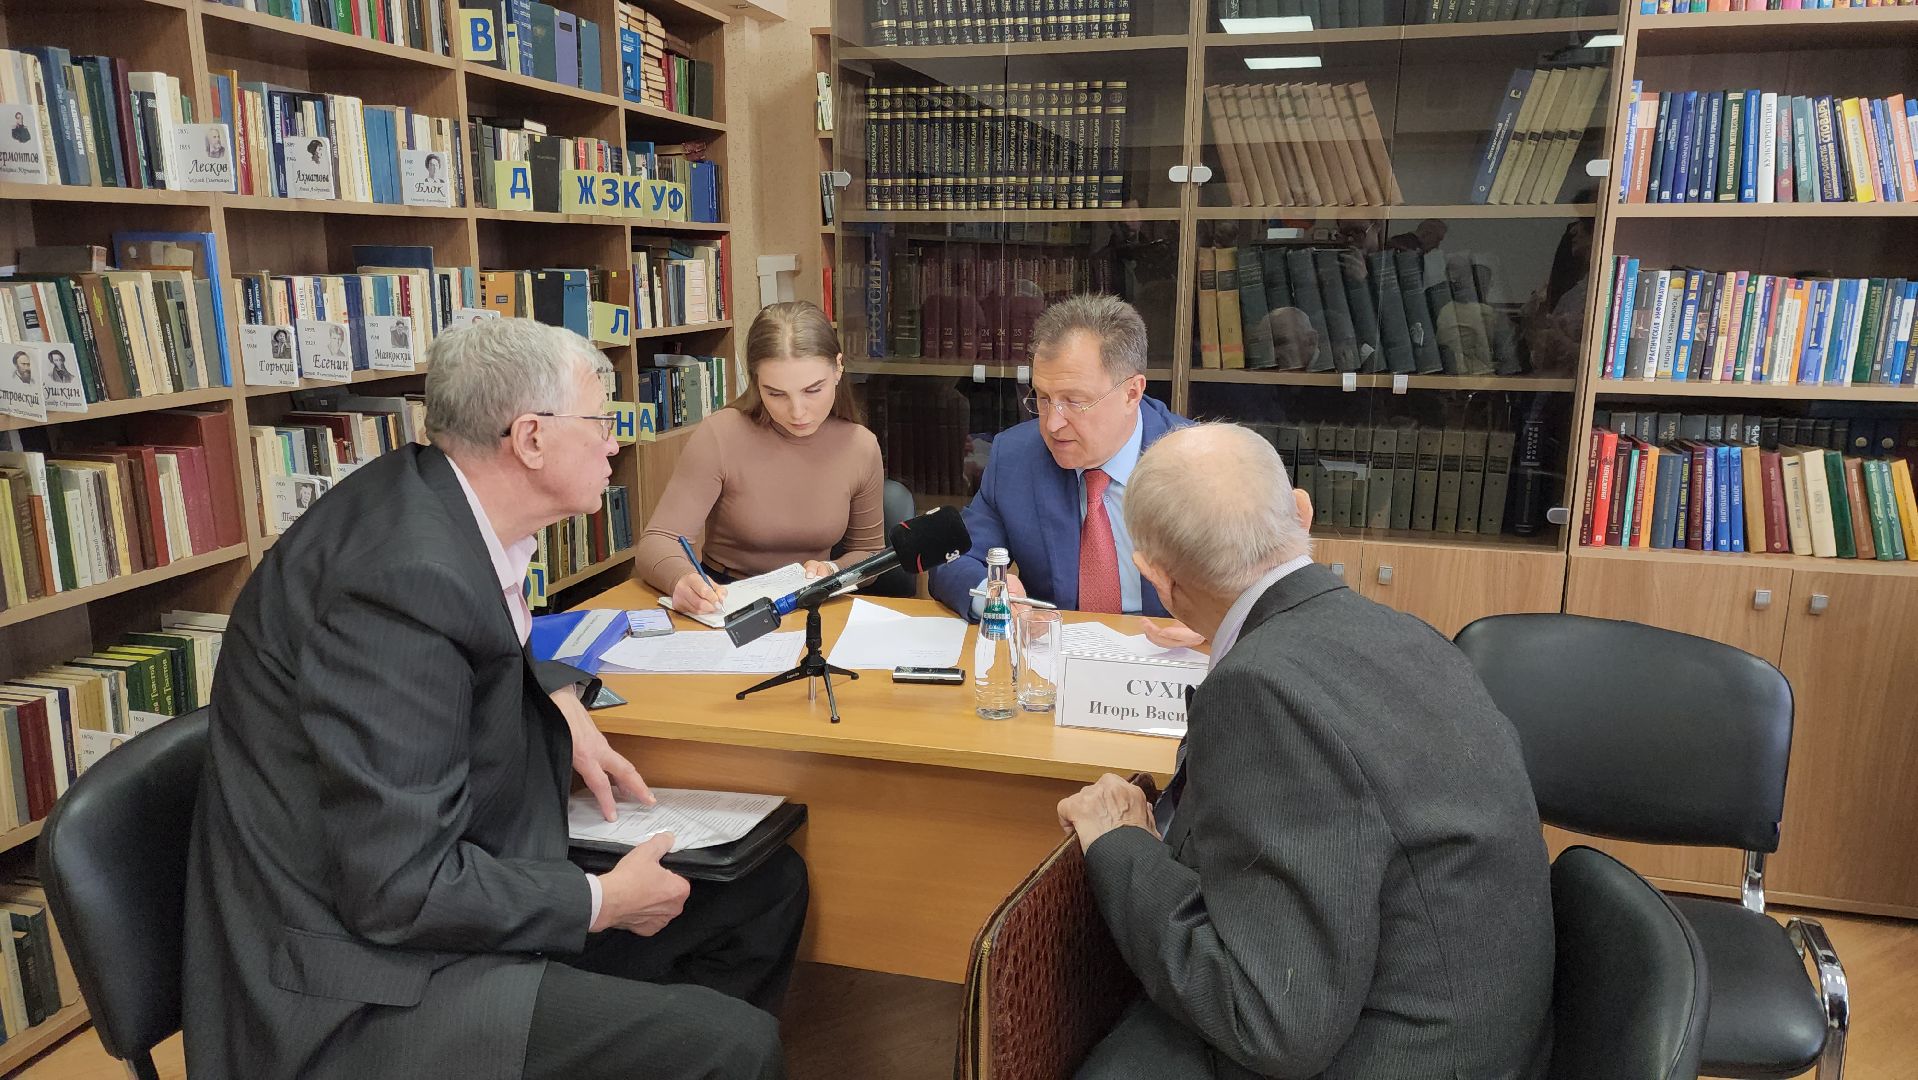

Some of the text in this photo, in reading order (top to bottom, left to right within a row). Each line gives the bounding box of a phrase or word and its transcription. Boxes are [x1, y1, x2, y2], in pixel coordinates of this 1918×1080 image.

[470, 18, 493, 51] В
[1727, 103, 1740, 190] ФИНАНСОВЫЙ МЕНЕДЖМЕНТ
[1764, 103, 1773, 167] КУЛЬТУРОЛОГИЯ
[0, 152, 40, 167] ермонтов
[1818, 99, 1832, 199] КУЛЬТУРОЛОГИЯ СЛОВАРЬ
[188, 160, 228, 174] Лесков
[296, 170, 330, 184] Ахматова
[415, 182, 445, 197] Блок
[510, 168, 530, 200] Д
[577, 176, 596, 205] Ж
[602, 179, 620, 206] З
[624, 181, 642, 208] К
[650, 186, 666, 210] У
[668, 188, 684, 212] Ф
[611, 308, 628, 336] Л
[1648, 276, 1666, 363] ПРАКТИЧЕСКАЯ ИНФОРМАТИКА
[981, 328, 990, 337] 24
[258, 360, 294, 376] Горький
[313, 354, 349, 372] Есенин
[374, 349, 411, 363] Маяковский
[0, 389, 39, 407] стровский
[617, 411, 634, 437] Н
[640, 408, 654, 433] А
[1089, 700, 1139, 720] Игорь
